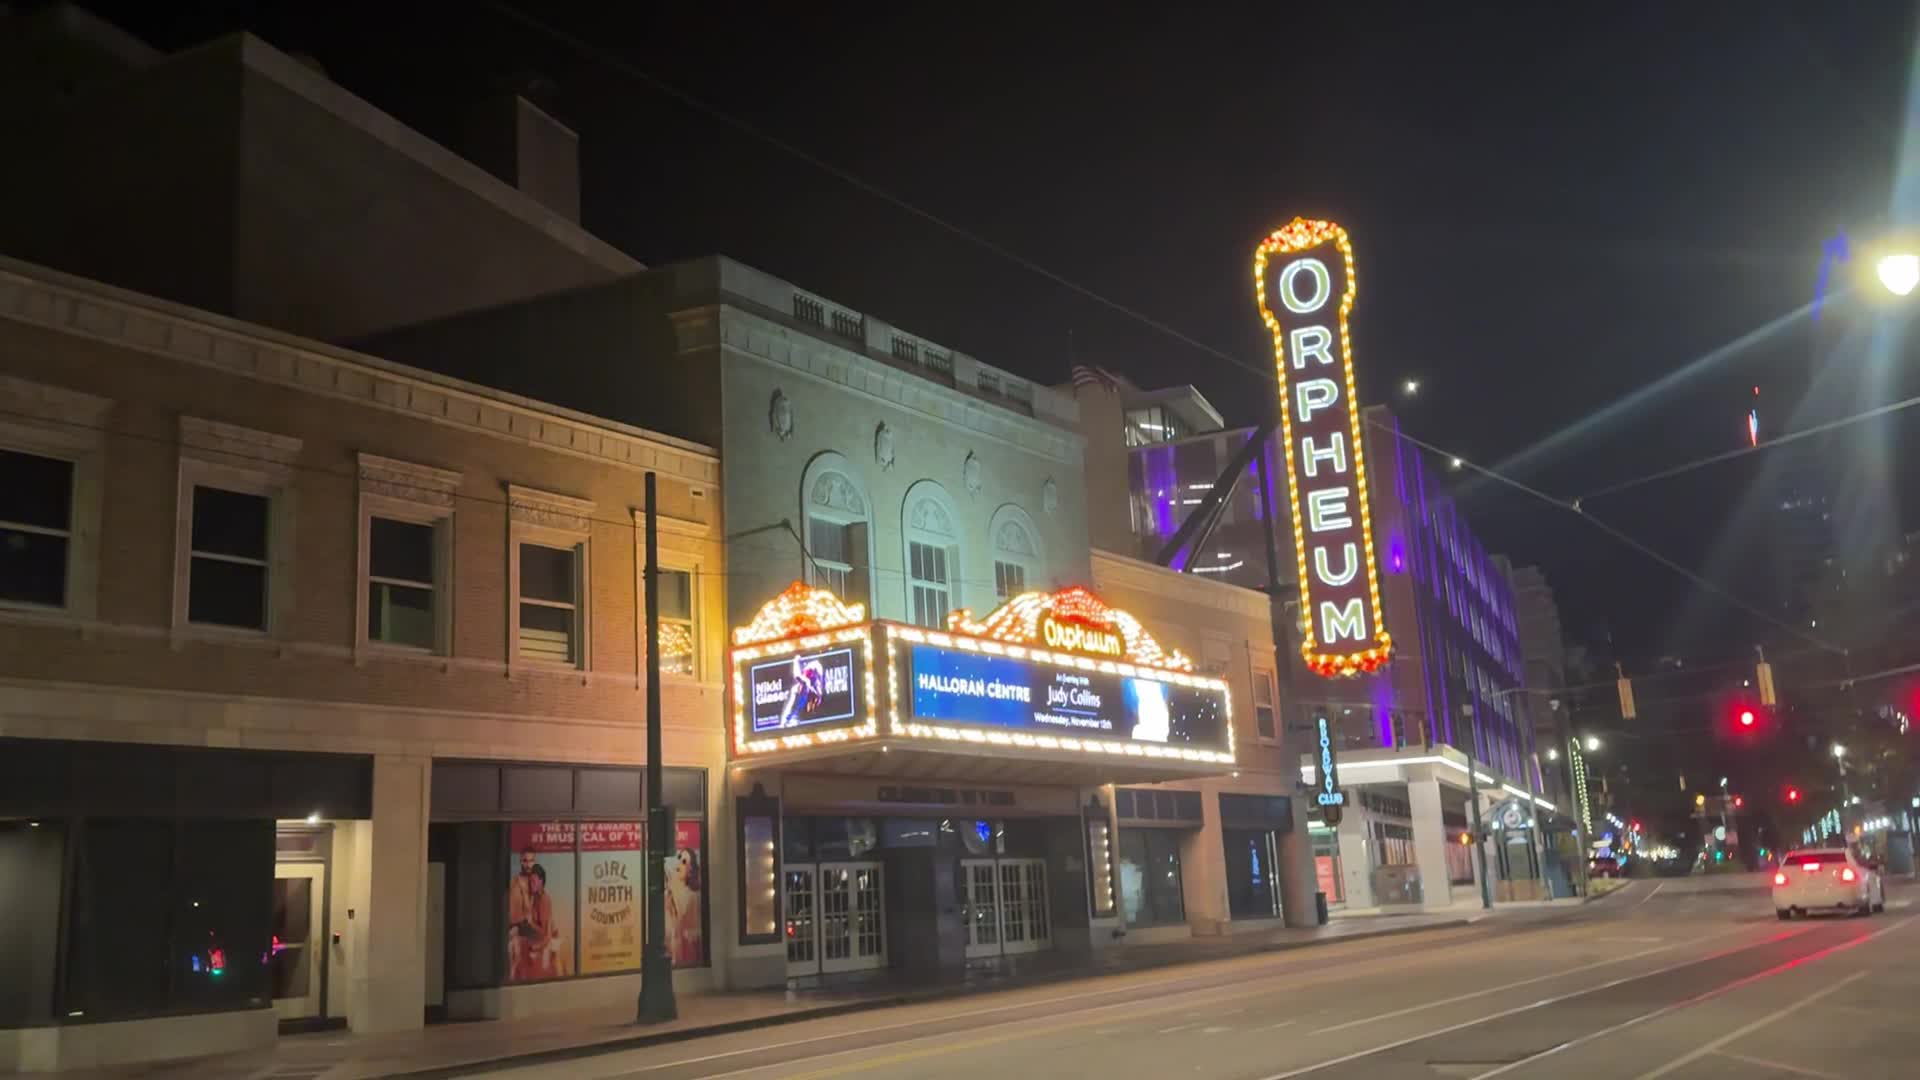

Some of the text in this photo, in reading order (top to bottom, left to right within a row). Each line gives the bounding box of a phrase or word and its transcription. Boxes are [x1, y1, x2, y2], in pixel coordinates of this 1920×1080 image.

[1279, 258, 1367, 644] ORPHEUM
[756, 678, 782, 694] Nikki
[918, 673, 1031, 703] HALLORAN CENTRE
[1047, 685, 1101, 708] Judy Collins
[1070, 716, 1099, 729] November
[1319, 718, 1333, 793] BROADWAY
[1318, 792, 1344, 806] CLUB
[539, 822, 561, 833] THE
[610, 831, 624, 841] OF
[593, 859, 629, 880] GIRL
[587, 885, 633, 905] NORTH
[590, 905, 631, 925] COUNTRY
